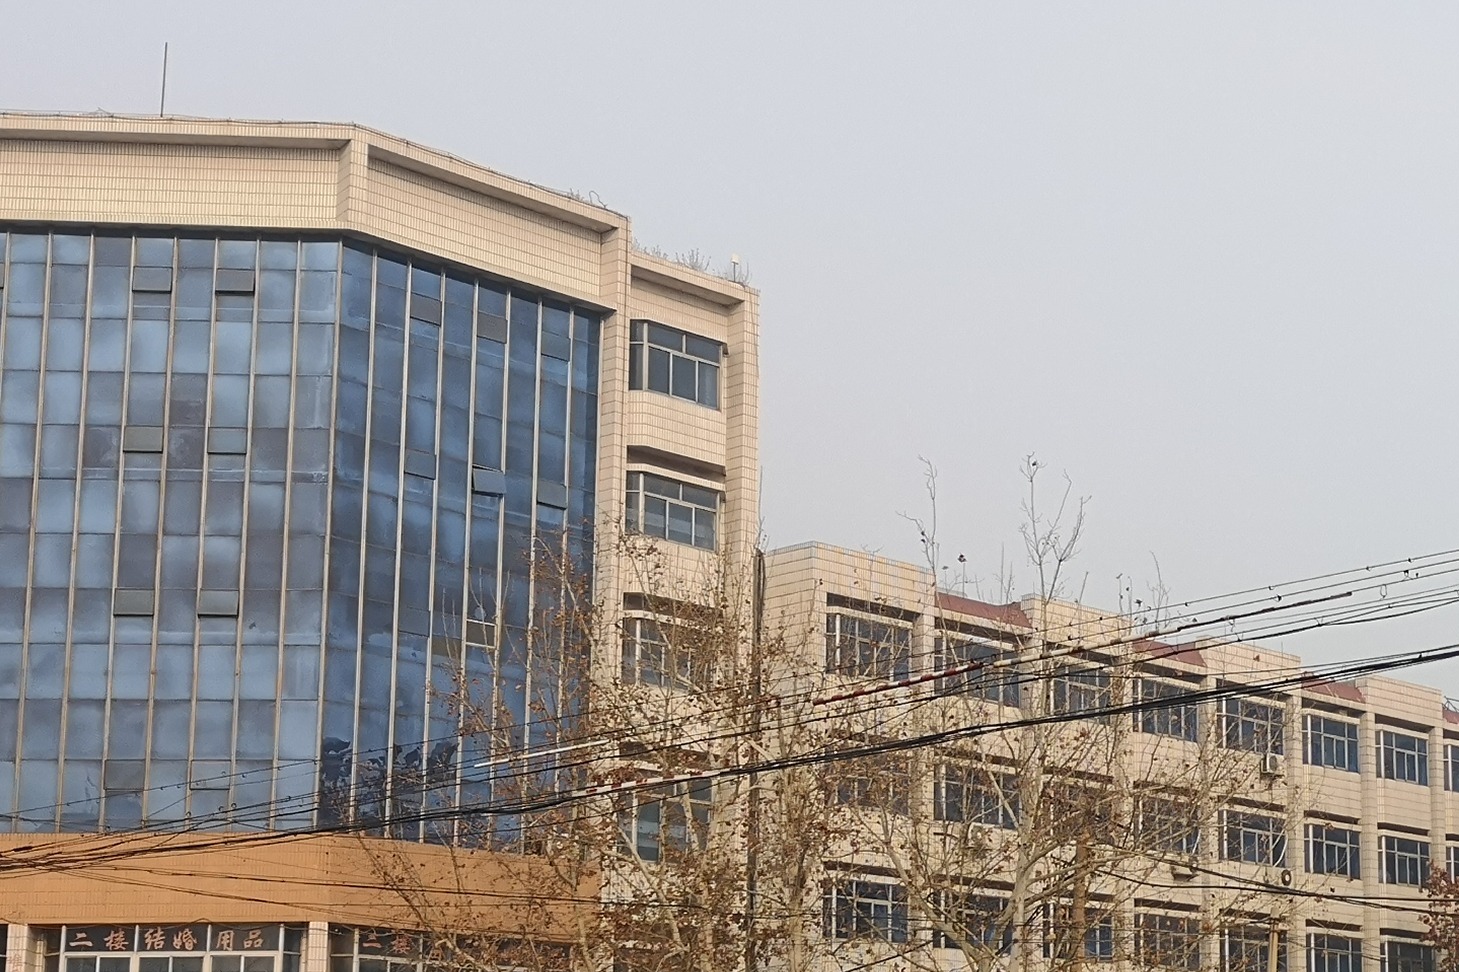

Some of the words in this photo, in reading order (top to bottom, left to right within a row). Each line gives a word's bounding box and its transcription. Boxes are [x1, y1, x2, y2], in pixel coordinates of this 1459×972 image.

[69, 929, 264, 950] 二楼结婚用品
